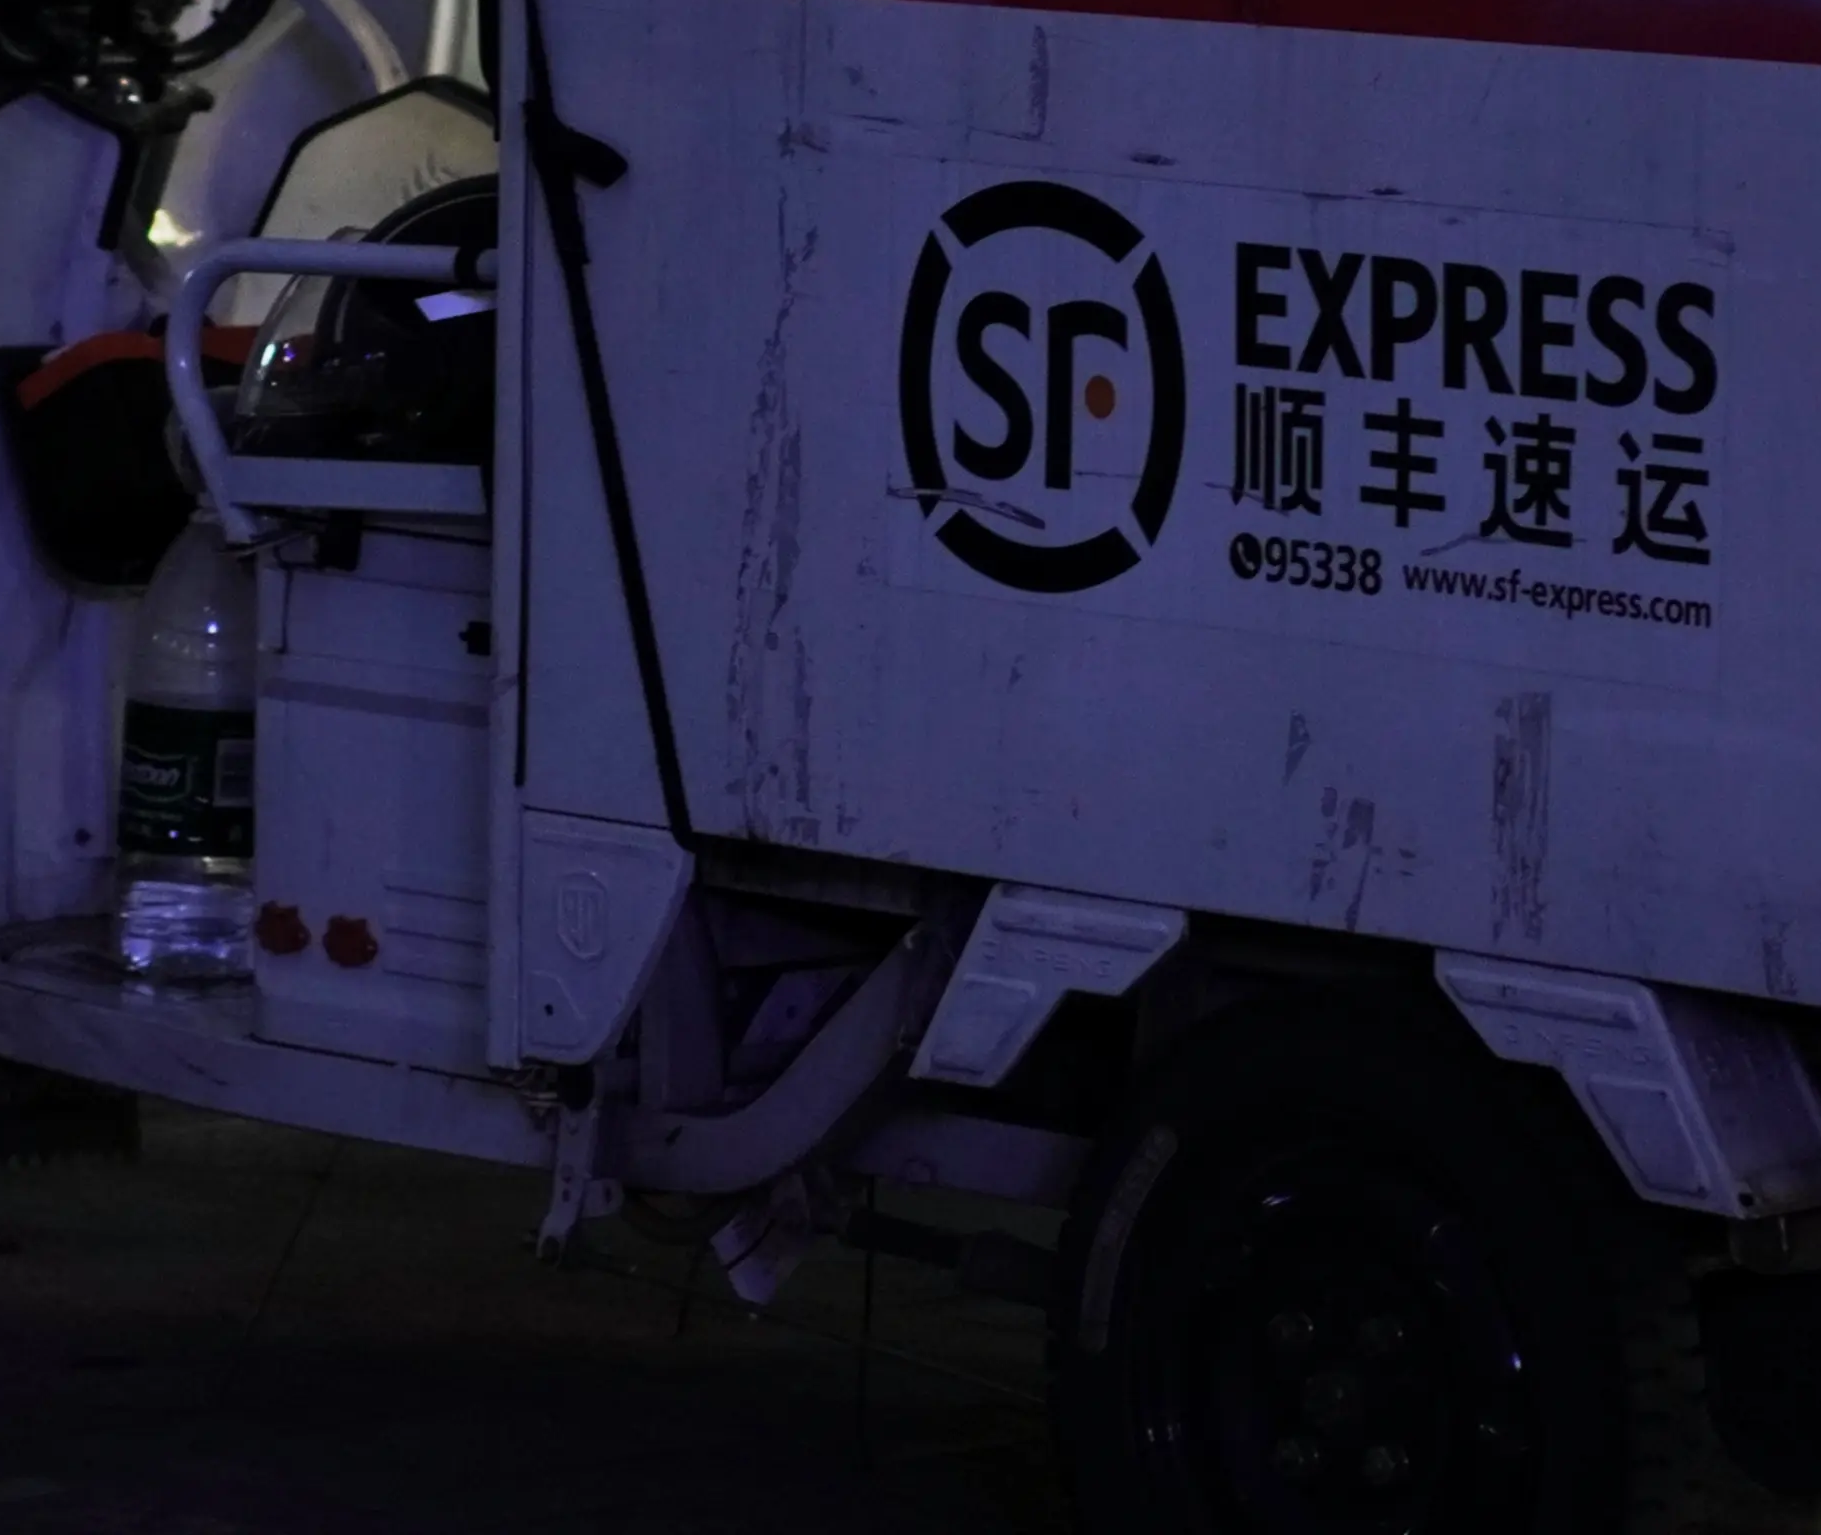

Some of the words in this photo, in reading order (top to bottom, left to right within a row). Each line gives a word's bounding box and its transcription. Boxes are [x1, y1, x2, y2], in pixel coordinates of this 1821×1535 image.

[1235, 241, 1718, 415] EXPRESS
[1232, 382, 1711, 565] 顺丰速运
[1265, 537, 1382, 596] 95338
[1402, 563, 1712, 628] www.sf-express.com
